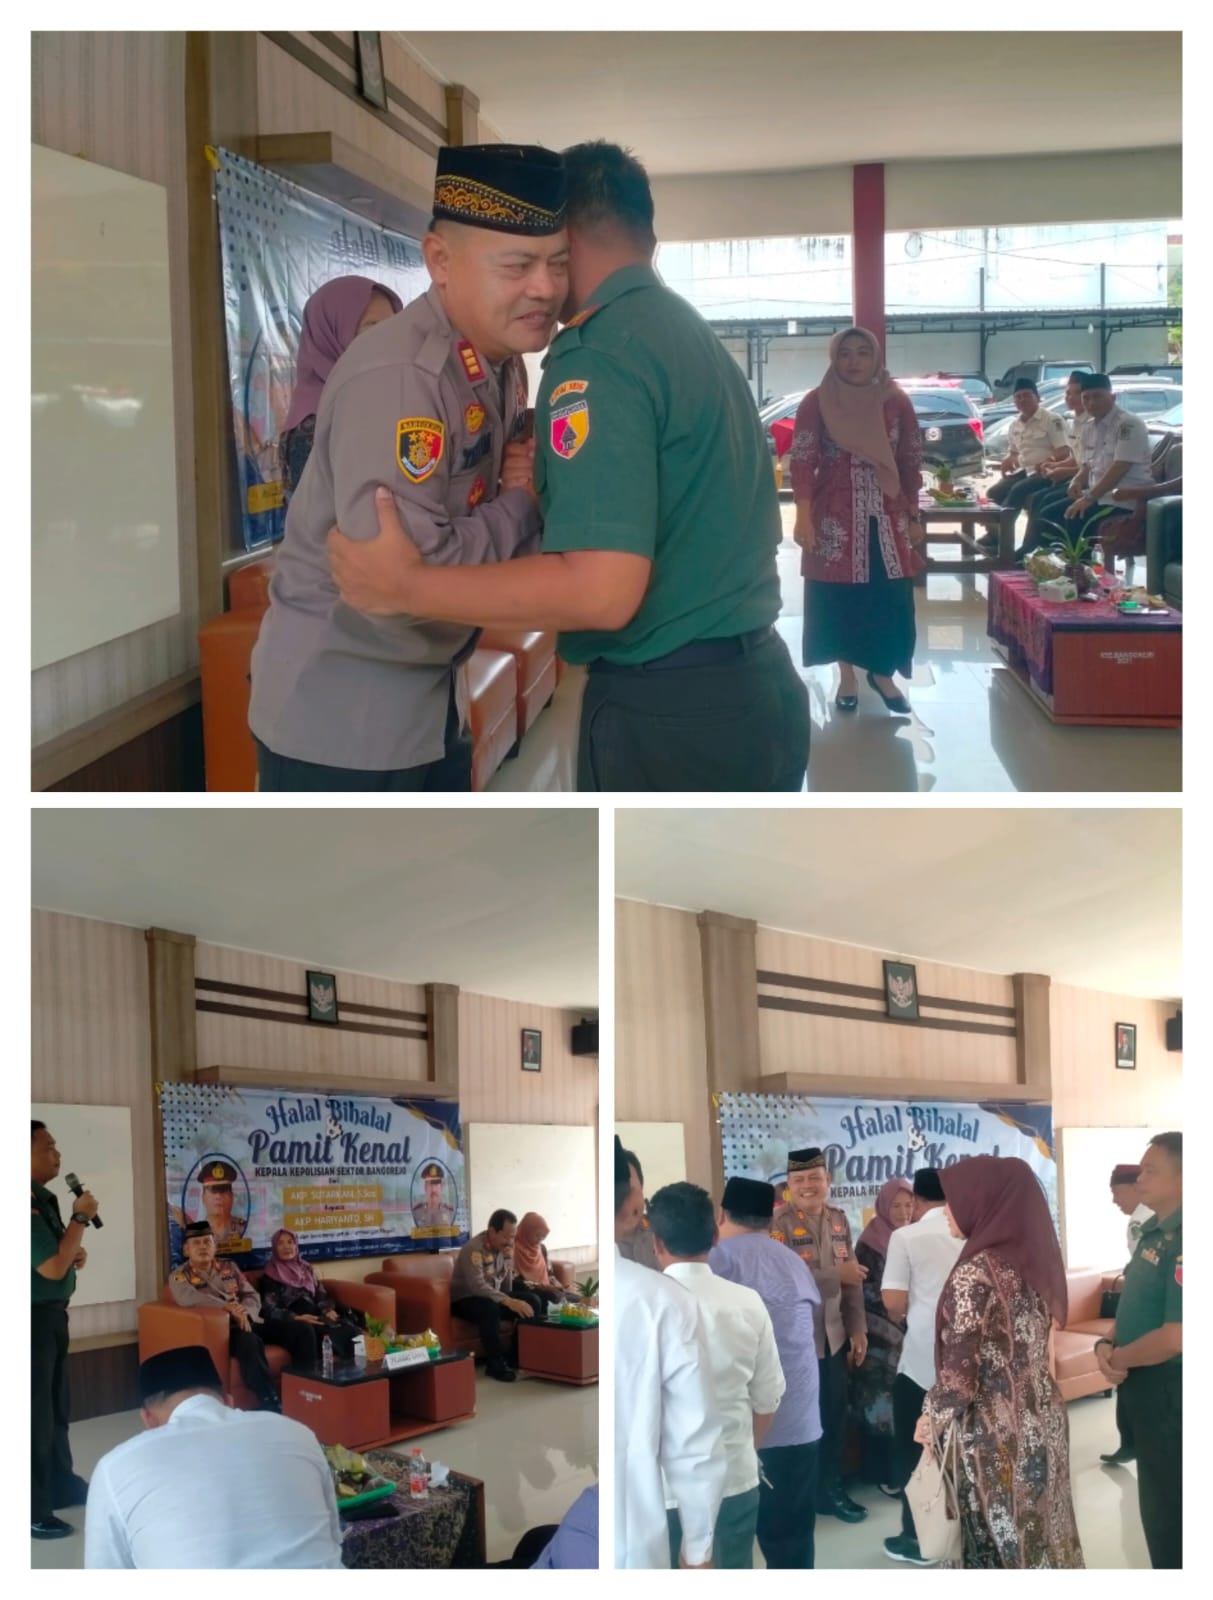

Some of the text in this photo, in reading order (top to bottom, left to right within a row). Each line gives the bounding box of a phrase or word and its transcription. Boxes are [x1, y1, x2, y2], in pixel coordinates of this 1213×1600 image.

[266, 1097, 392, 1135] Halal Bihalal
[840, 1105, 980, 1149] Halal Bihalal
[248, 1129, 412, 1165] Pamit Kenal
[907, 1124, 928, 1151] &
[255, 1166, 407, 1177] KEPALA KEPOLISIAN SEKTOR BANGOREJO
[824, 1143, 915, 1182] Pamit
[830, 1184, 867, 1199] KEPALA
